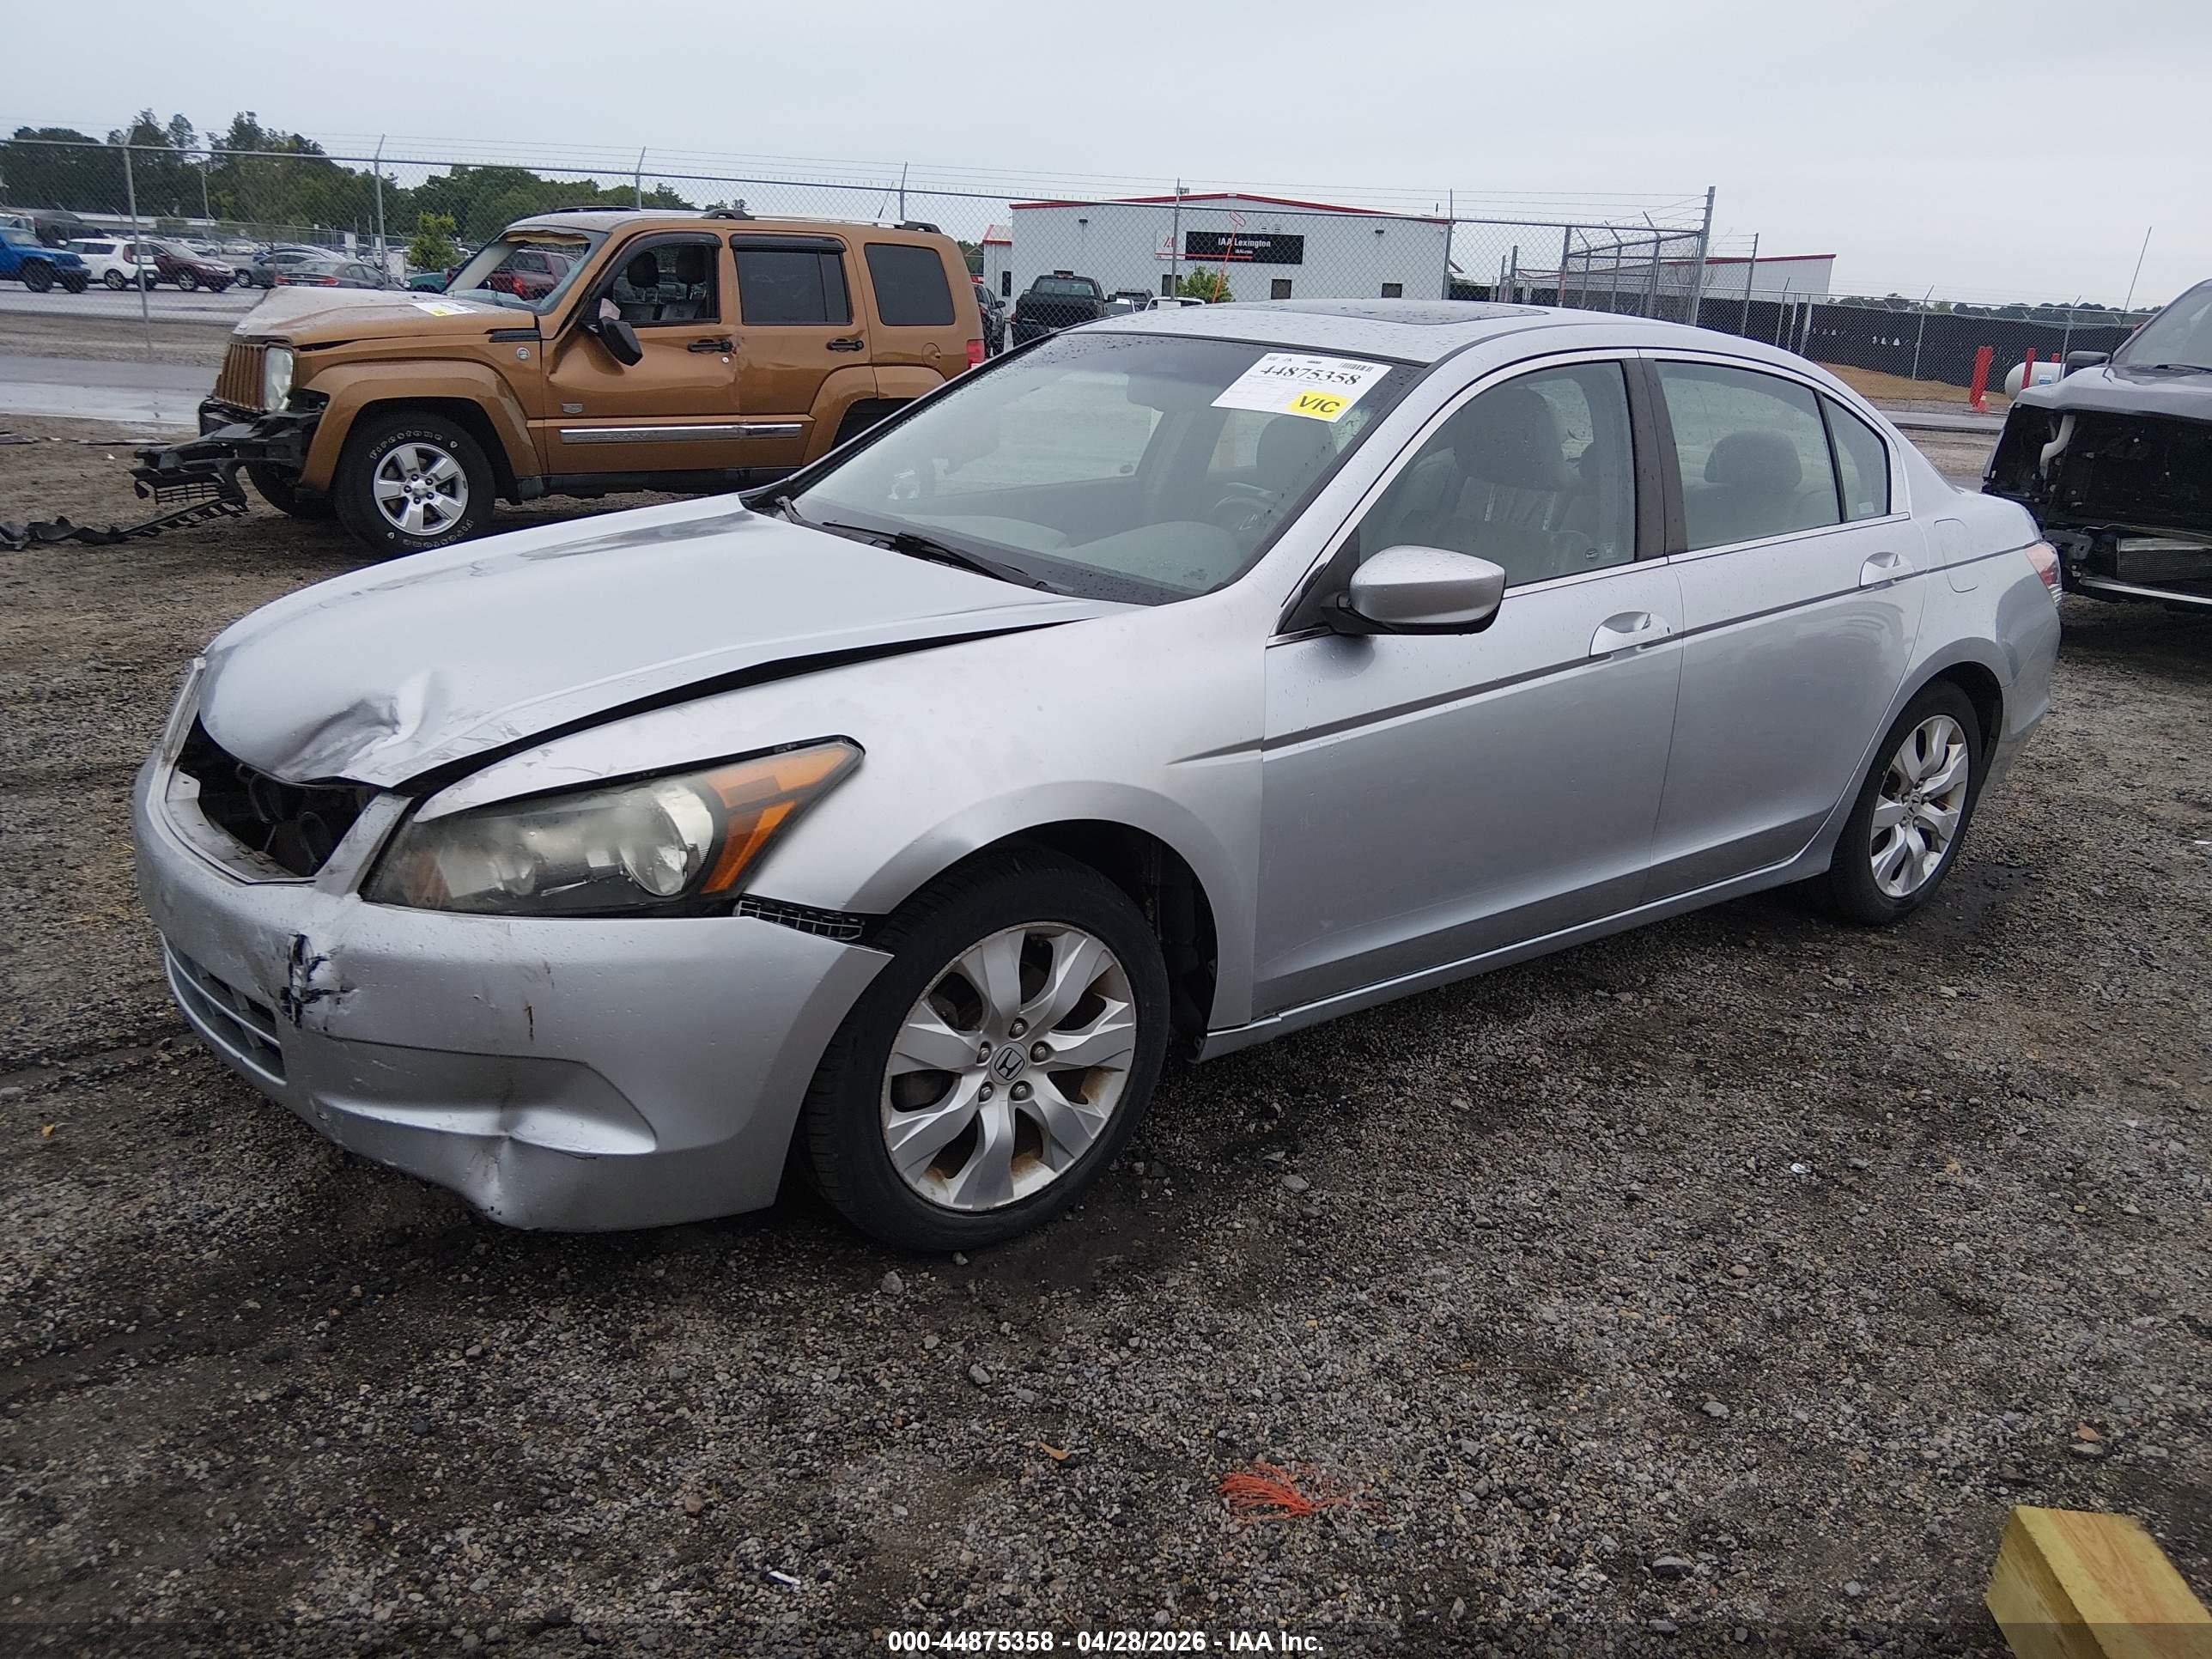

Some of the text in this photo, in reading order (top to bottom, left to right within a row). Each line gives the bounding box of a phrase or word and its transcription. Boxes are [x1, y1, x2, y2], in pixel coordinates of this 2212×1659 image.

[1218, 237, 1271, 248] IAA Lexington
[1260, 365, 1362, 386] 44875358
[1298, 395, 1340, 414] VIC
[369, 430, 443, 459] Firestone
